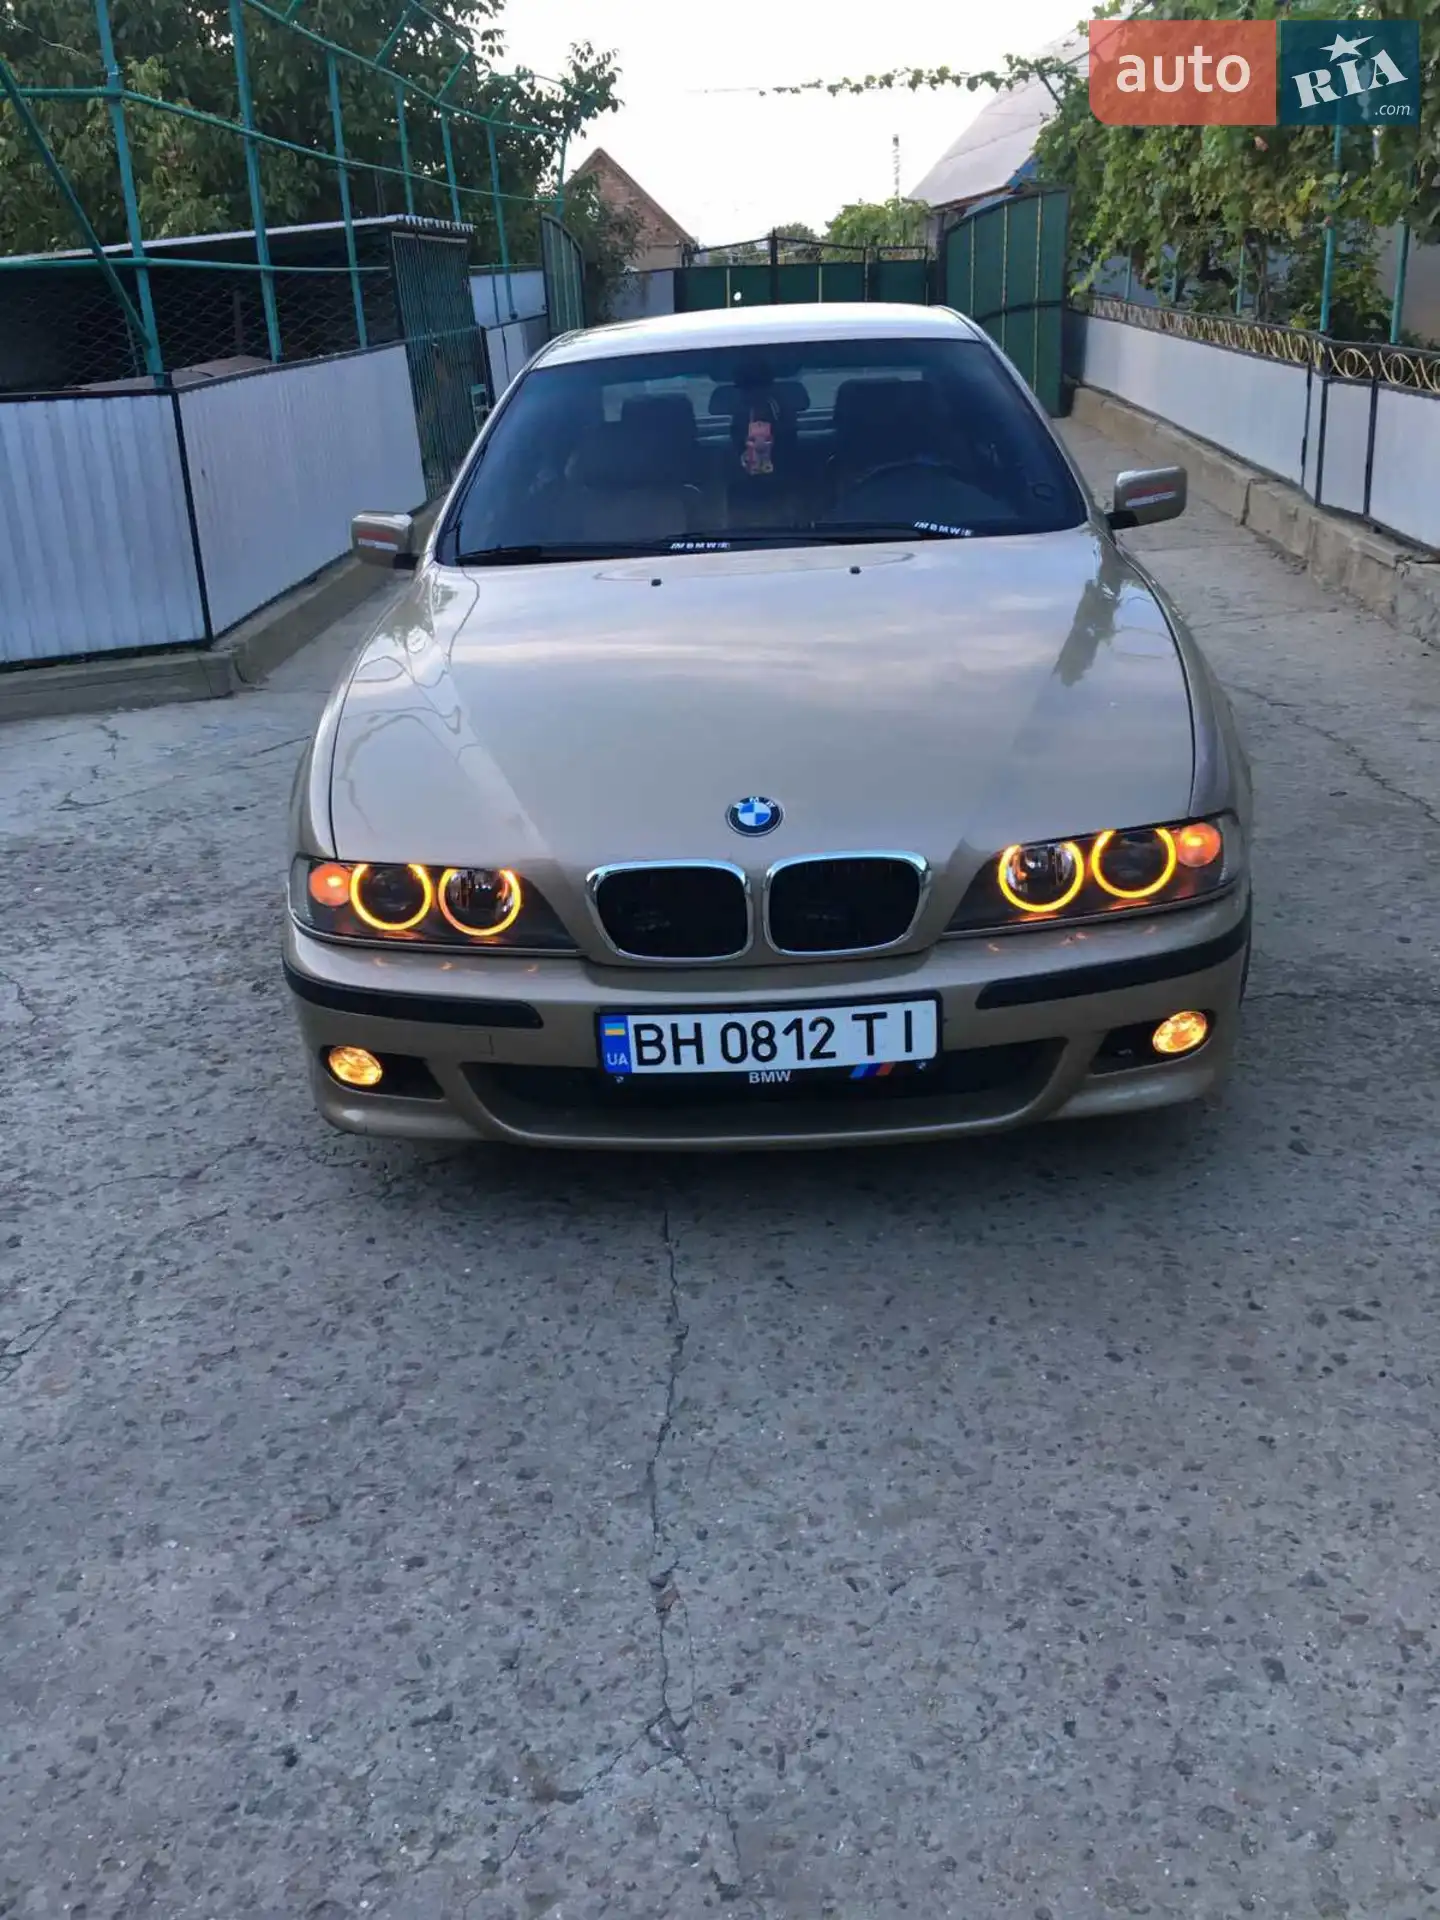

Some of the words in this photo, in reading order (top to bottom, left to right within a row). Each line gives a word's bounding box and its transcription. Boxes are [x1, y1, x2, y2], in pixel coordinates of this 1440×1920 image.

[633, 1022, 705, 1066] BH
[720, 1016, 837, 1064] 0812
[852, 1010, 913, 1056] TI
[606, 1051, 629, 1067] UA
[748, 1070, 791, 1084] BMW
